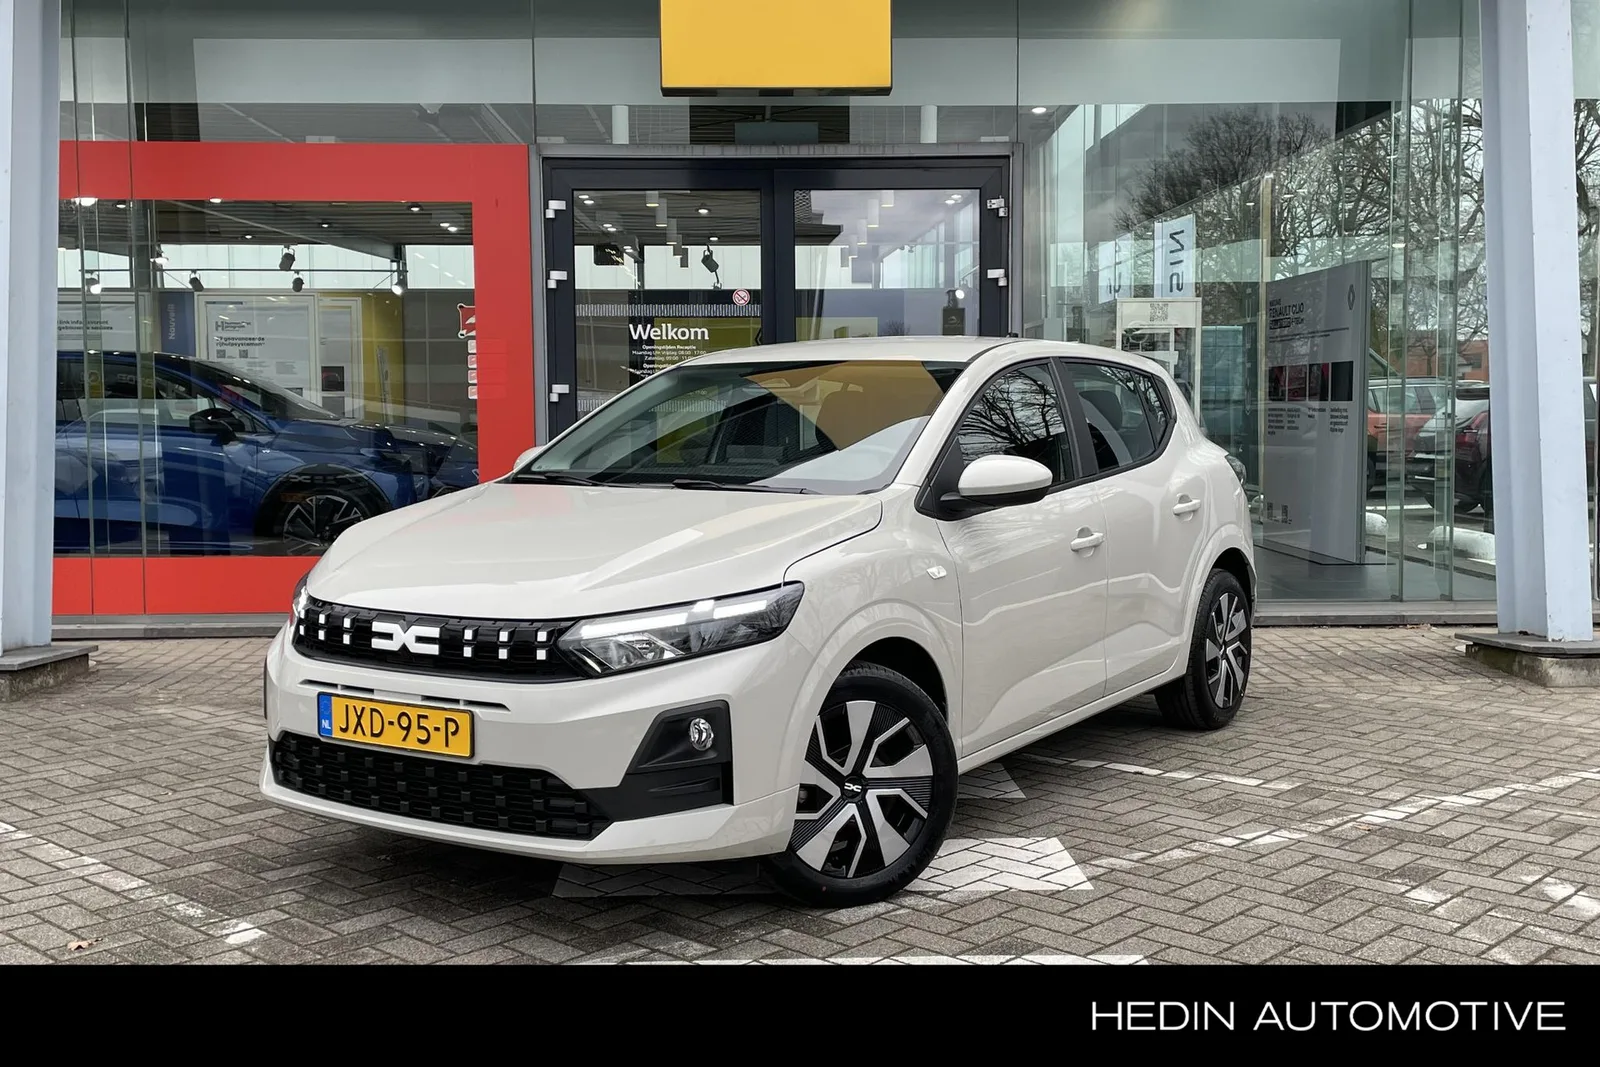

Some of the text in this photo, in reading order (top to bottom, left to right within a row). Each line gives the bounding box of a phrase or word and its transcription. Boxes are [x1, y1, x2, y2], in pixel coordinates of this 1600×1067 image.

[629, 323, 709, 340] Welkom
[321, 719, 332, 730] NL
[339, 704, 460, 748] JXD-95-P
